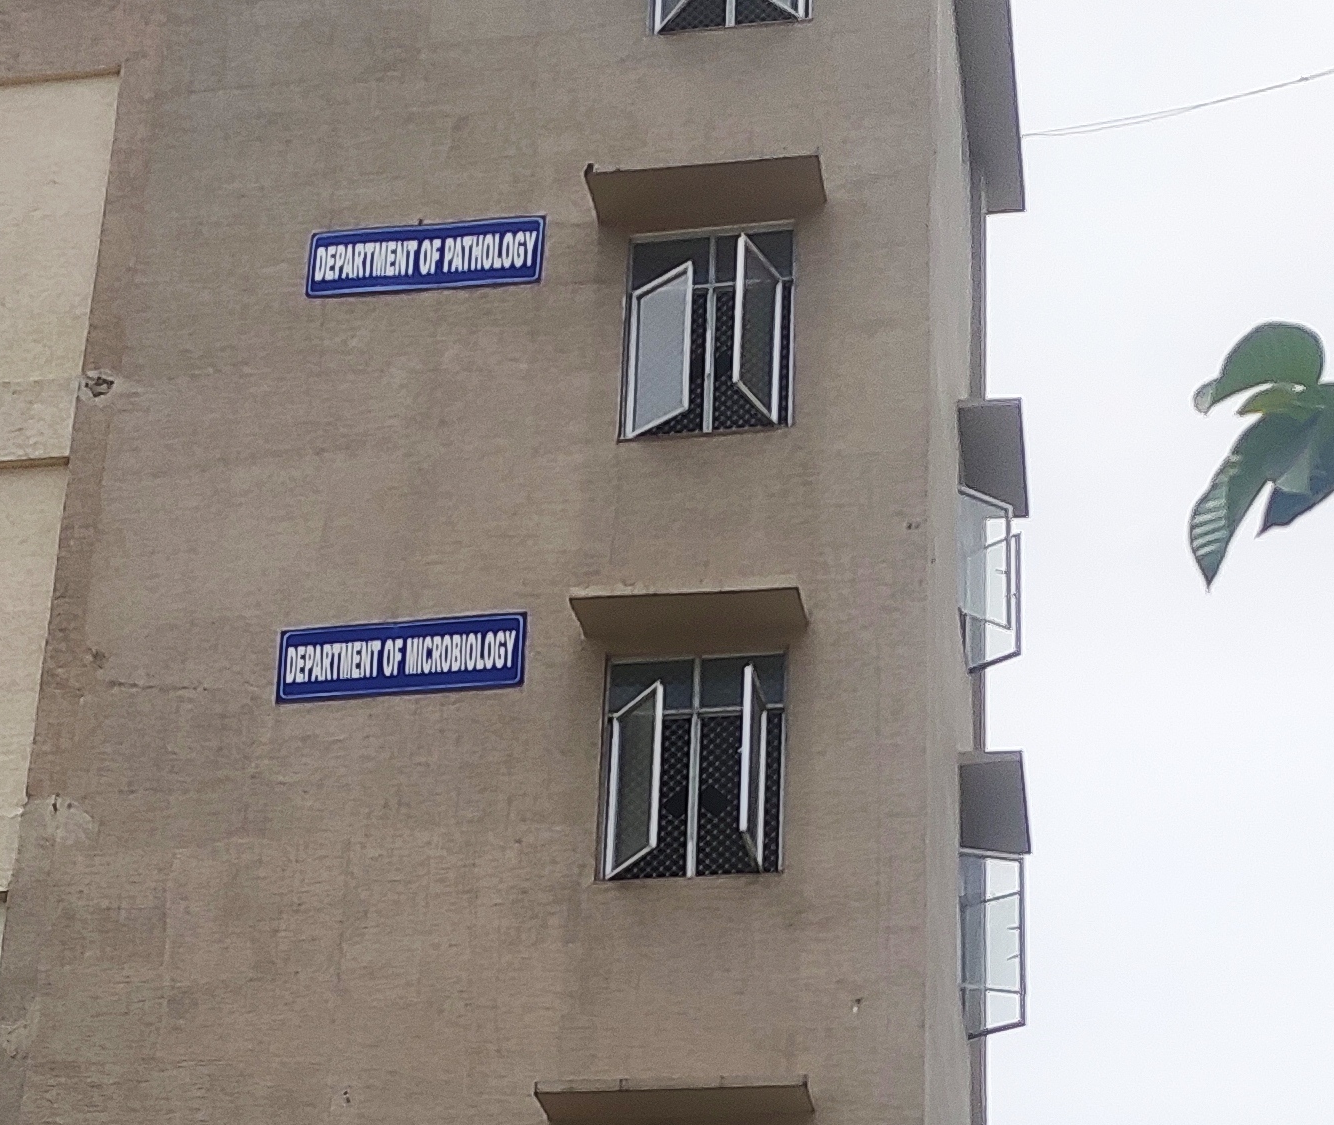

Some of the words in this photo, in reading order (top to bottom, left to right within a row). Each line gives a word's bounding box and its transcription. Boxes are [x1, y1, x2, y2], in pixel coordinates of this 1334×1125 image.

[314, 240, 418, 282] DEPARTMENT
[419, 238, 442, 275] OF
[442, 231, 537, 273] PATHOLOGY
[285, 640, 382, 684] DEPARTMENT
[383, 638, 403, 676] OF
[405, 630, 516, 675] MICROBIOLOGY
